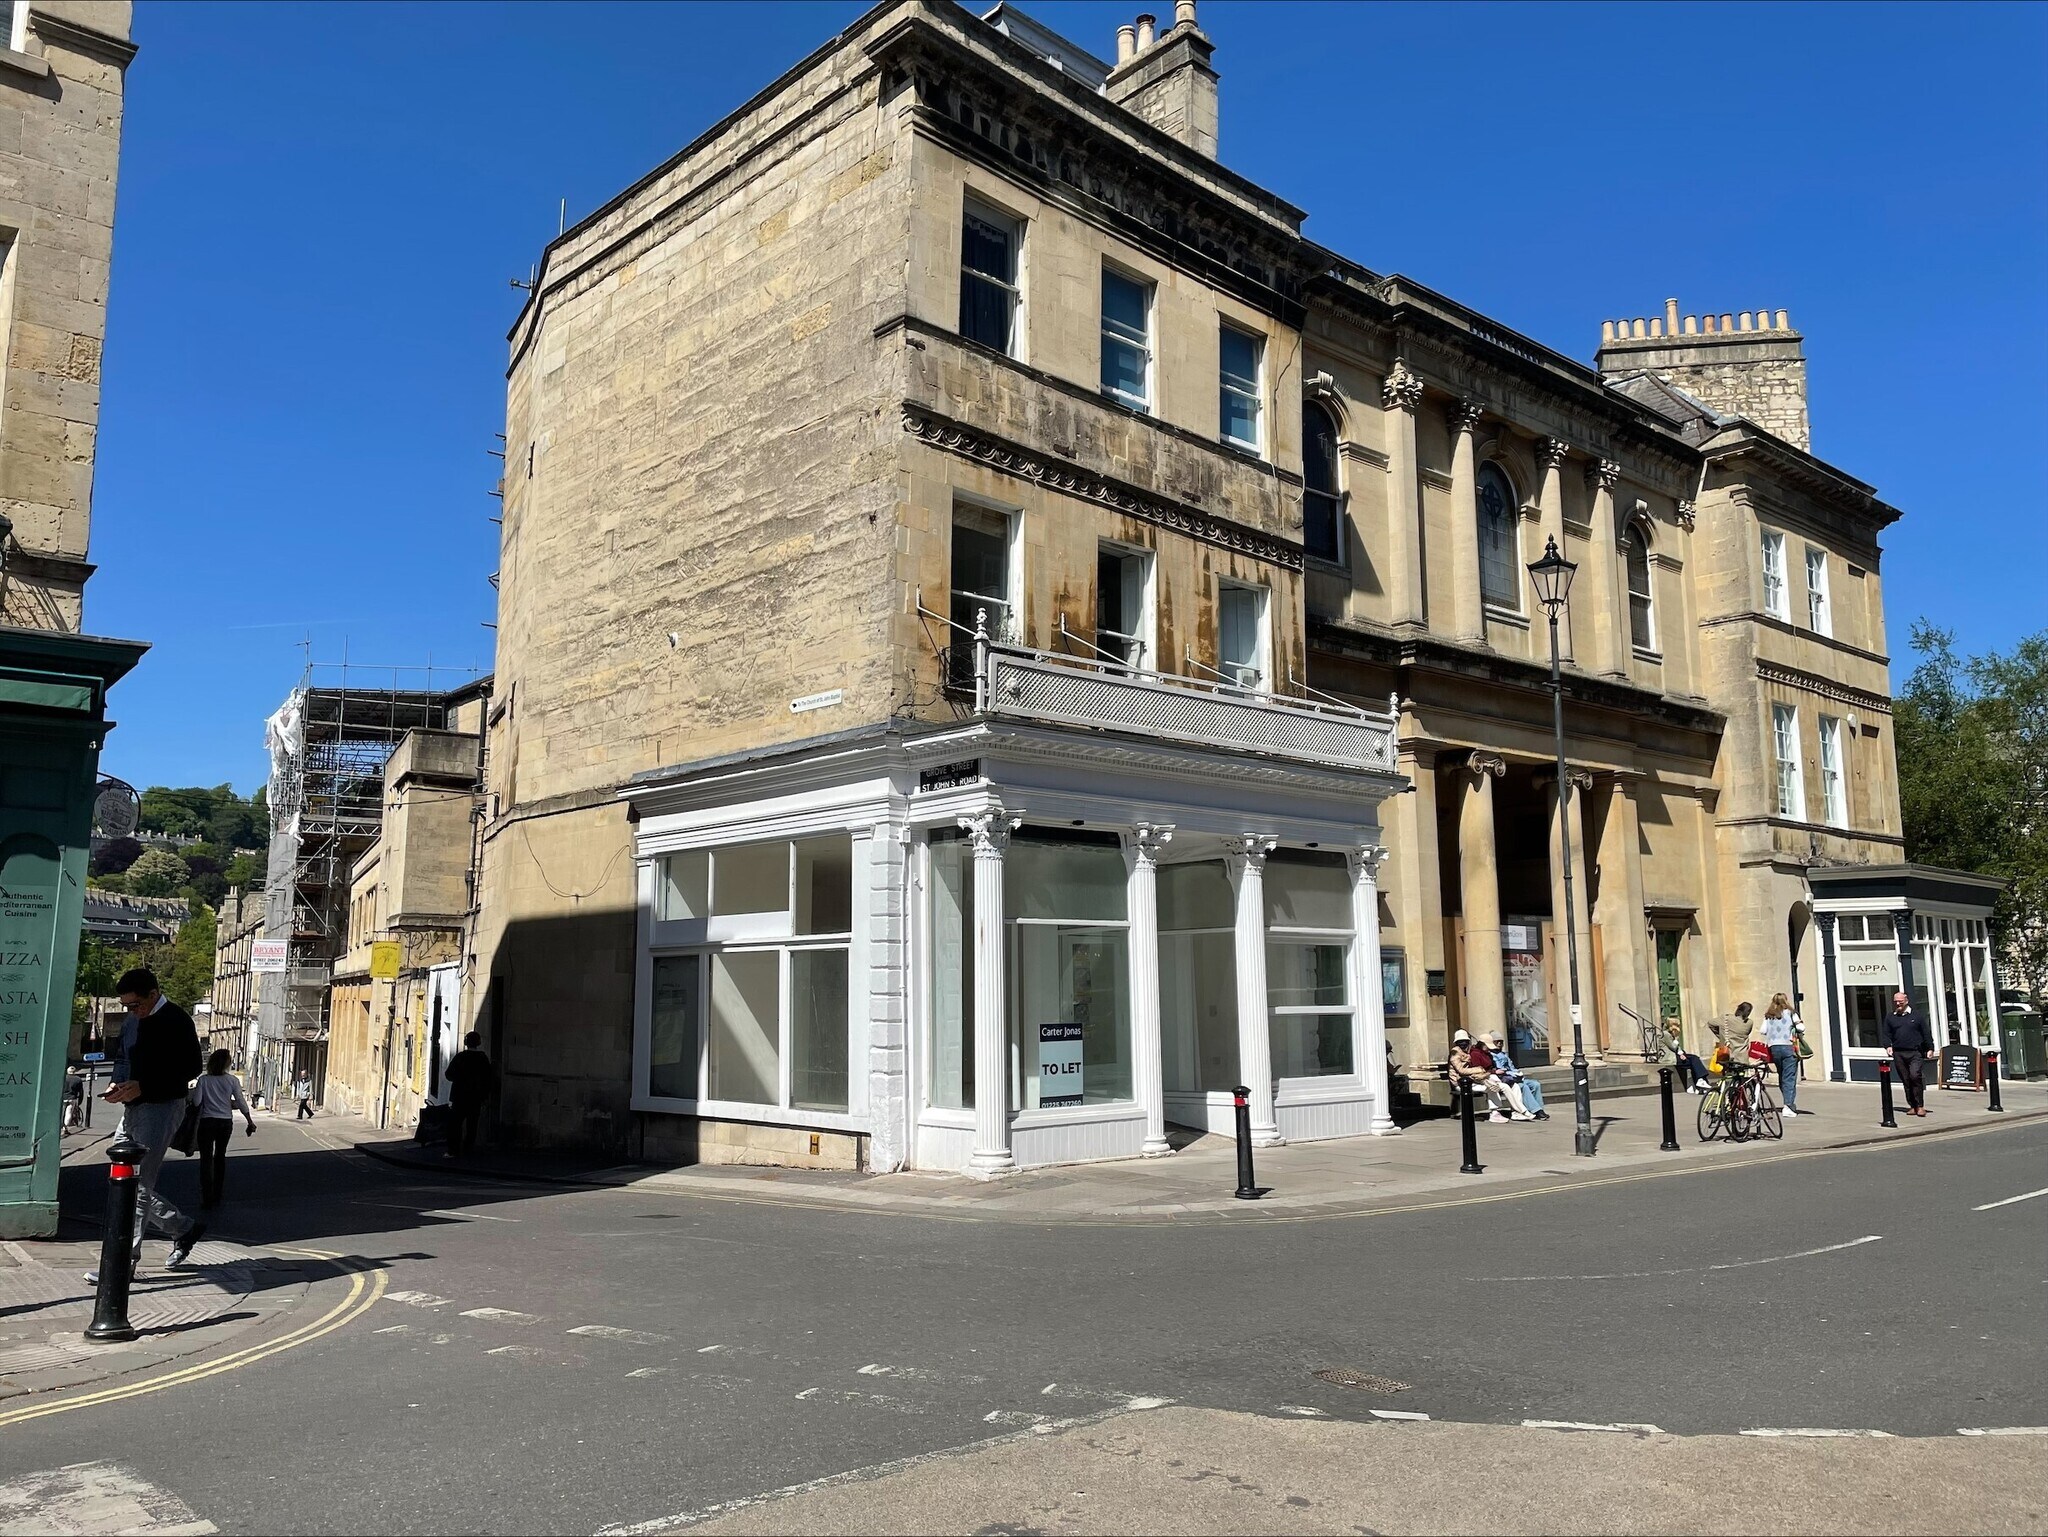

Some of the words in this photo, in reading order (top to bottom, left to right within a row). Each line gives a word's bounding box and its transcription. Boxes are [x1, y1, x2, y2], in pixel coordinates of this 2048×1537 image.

[925, 765, 948, 778] GROVE
[951, 760, 974, 773] STREET
[921, 783, 931, 793] ST
[960, 774, 978, 786] ROAD
[0, 901, 53, 909] editerranean
[254, 946, 286, 954] BRYANT
[0, 952, 42, 966] IZZA
[1848, 964, 1888, 973] DAPPA
[1041, 1027, 1063, 1037] Carter
[1064, 1026, 1082, 1037] Jonas
[1042, 1063, 1059, 1076] TO
[1061, 1062, 1082, 1075] LET
